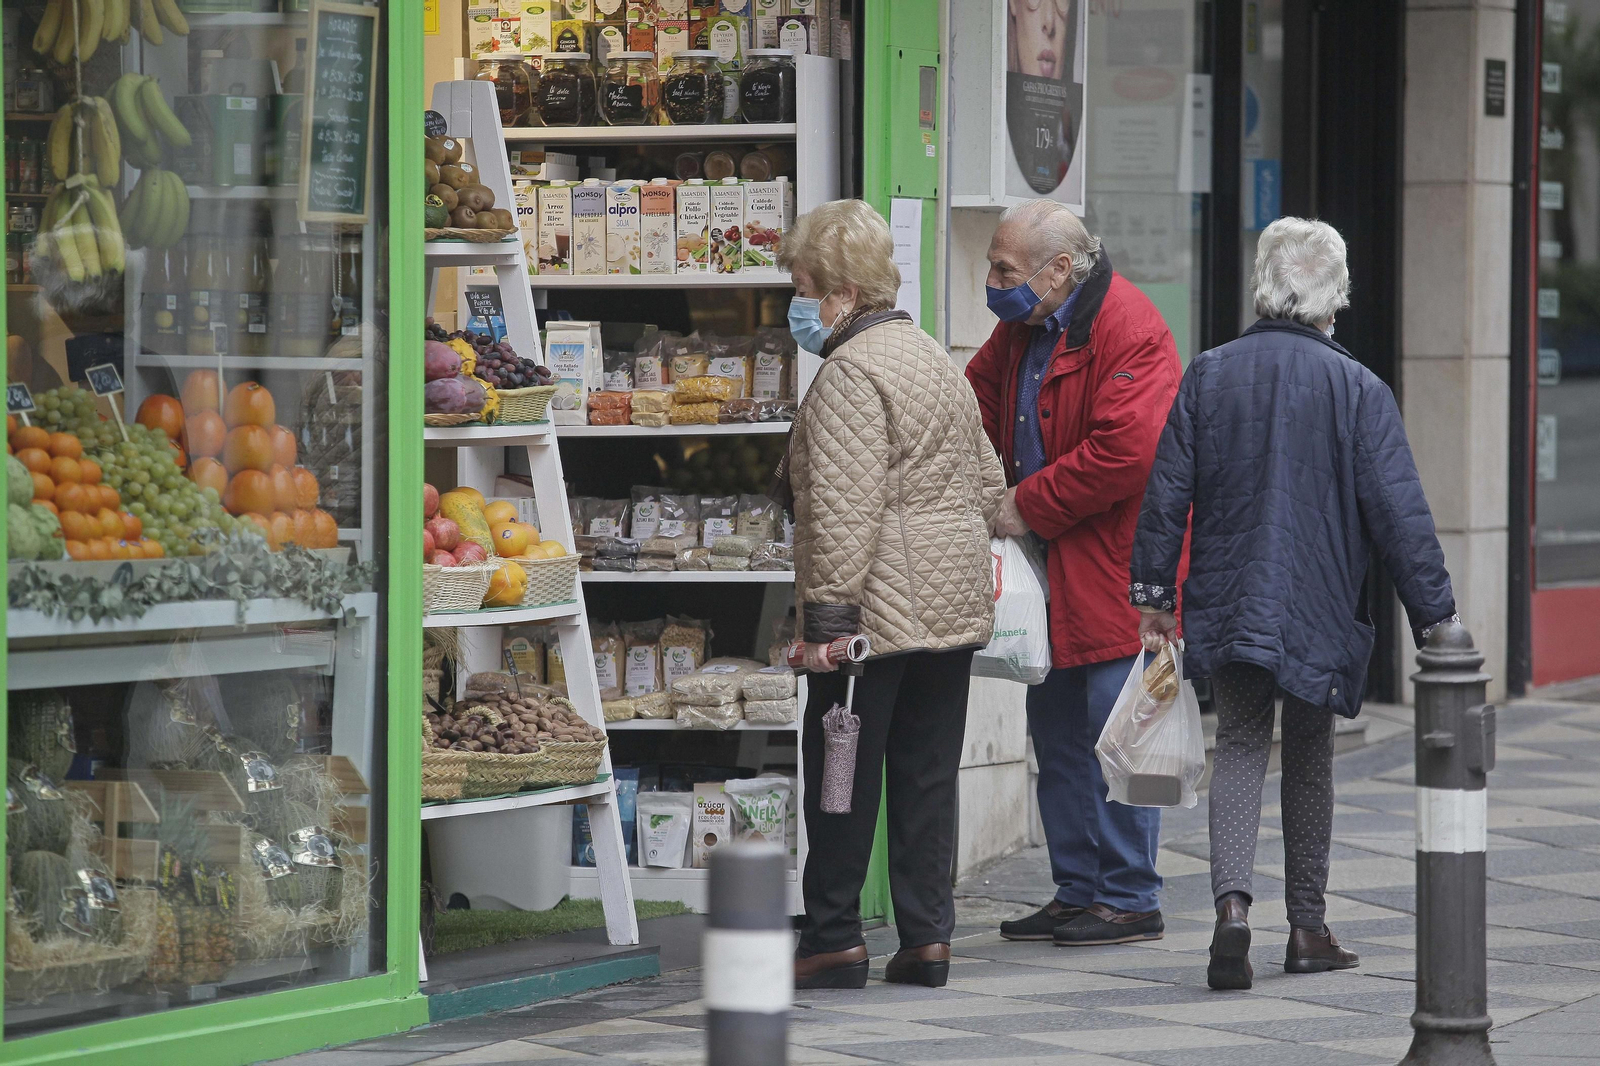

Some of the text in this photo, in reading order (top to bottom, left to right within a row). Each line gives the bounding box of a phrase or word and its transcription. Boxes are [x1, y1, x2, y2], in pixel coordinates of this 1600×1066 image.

[1035, 127, 1050, 149] 179
[573, 191, 603, 200] MONSOY
[642, 190, 671, 199] MONSOY
[517, 206, 534, 217] pro
[608, 203, 637, 218] alpro
[751, 203, 776, 211] Cocido
[616, 219, 630, 227] SOJA
[993, 627, 1027, 640] planeta
[697, 801, 725, 809] azúcar
[759, 821, 776, 834] BIO
